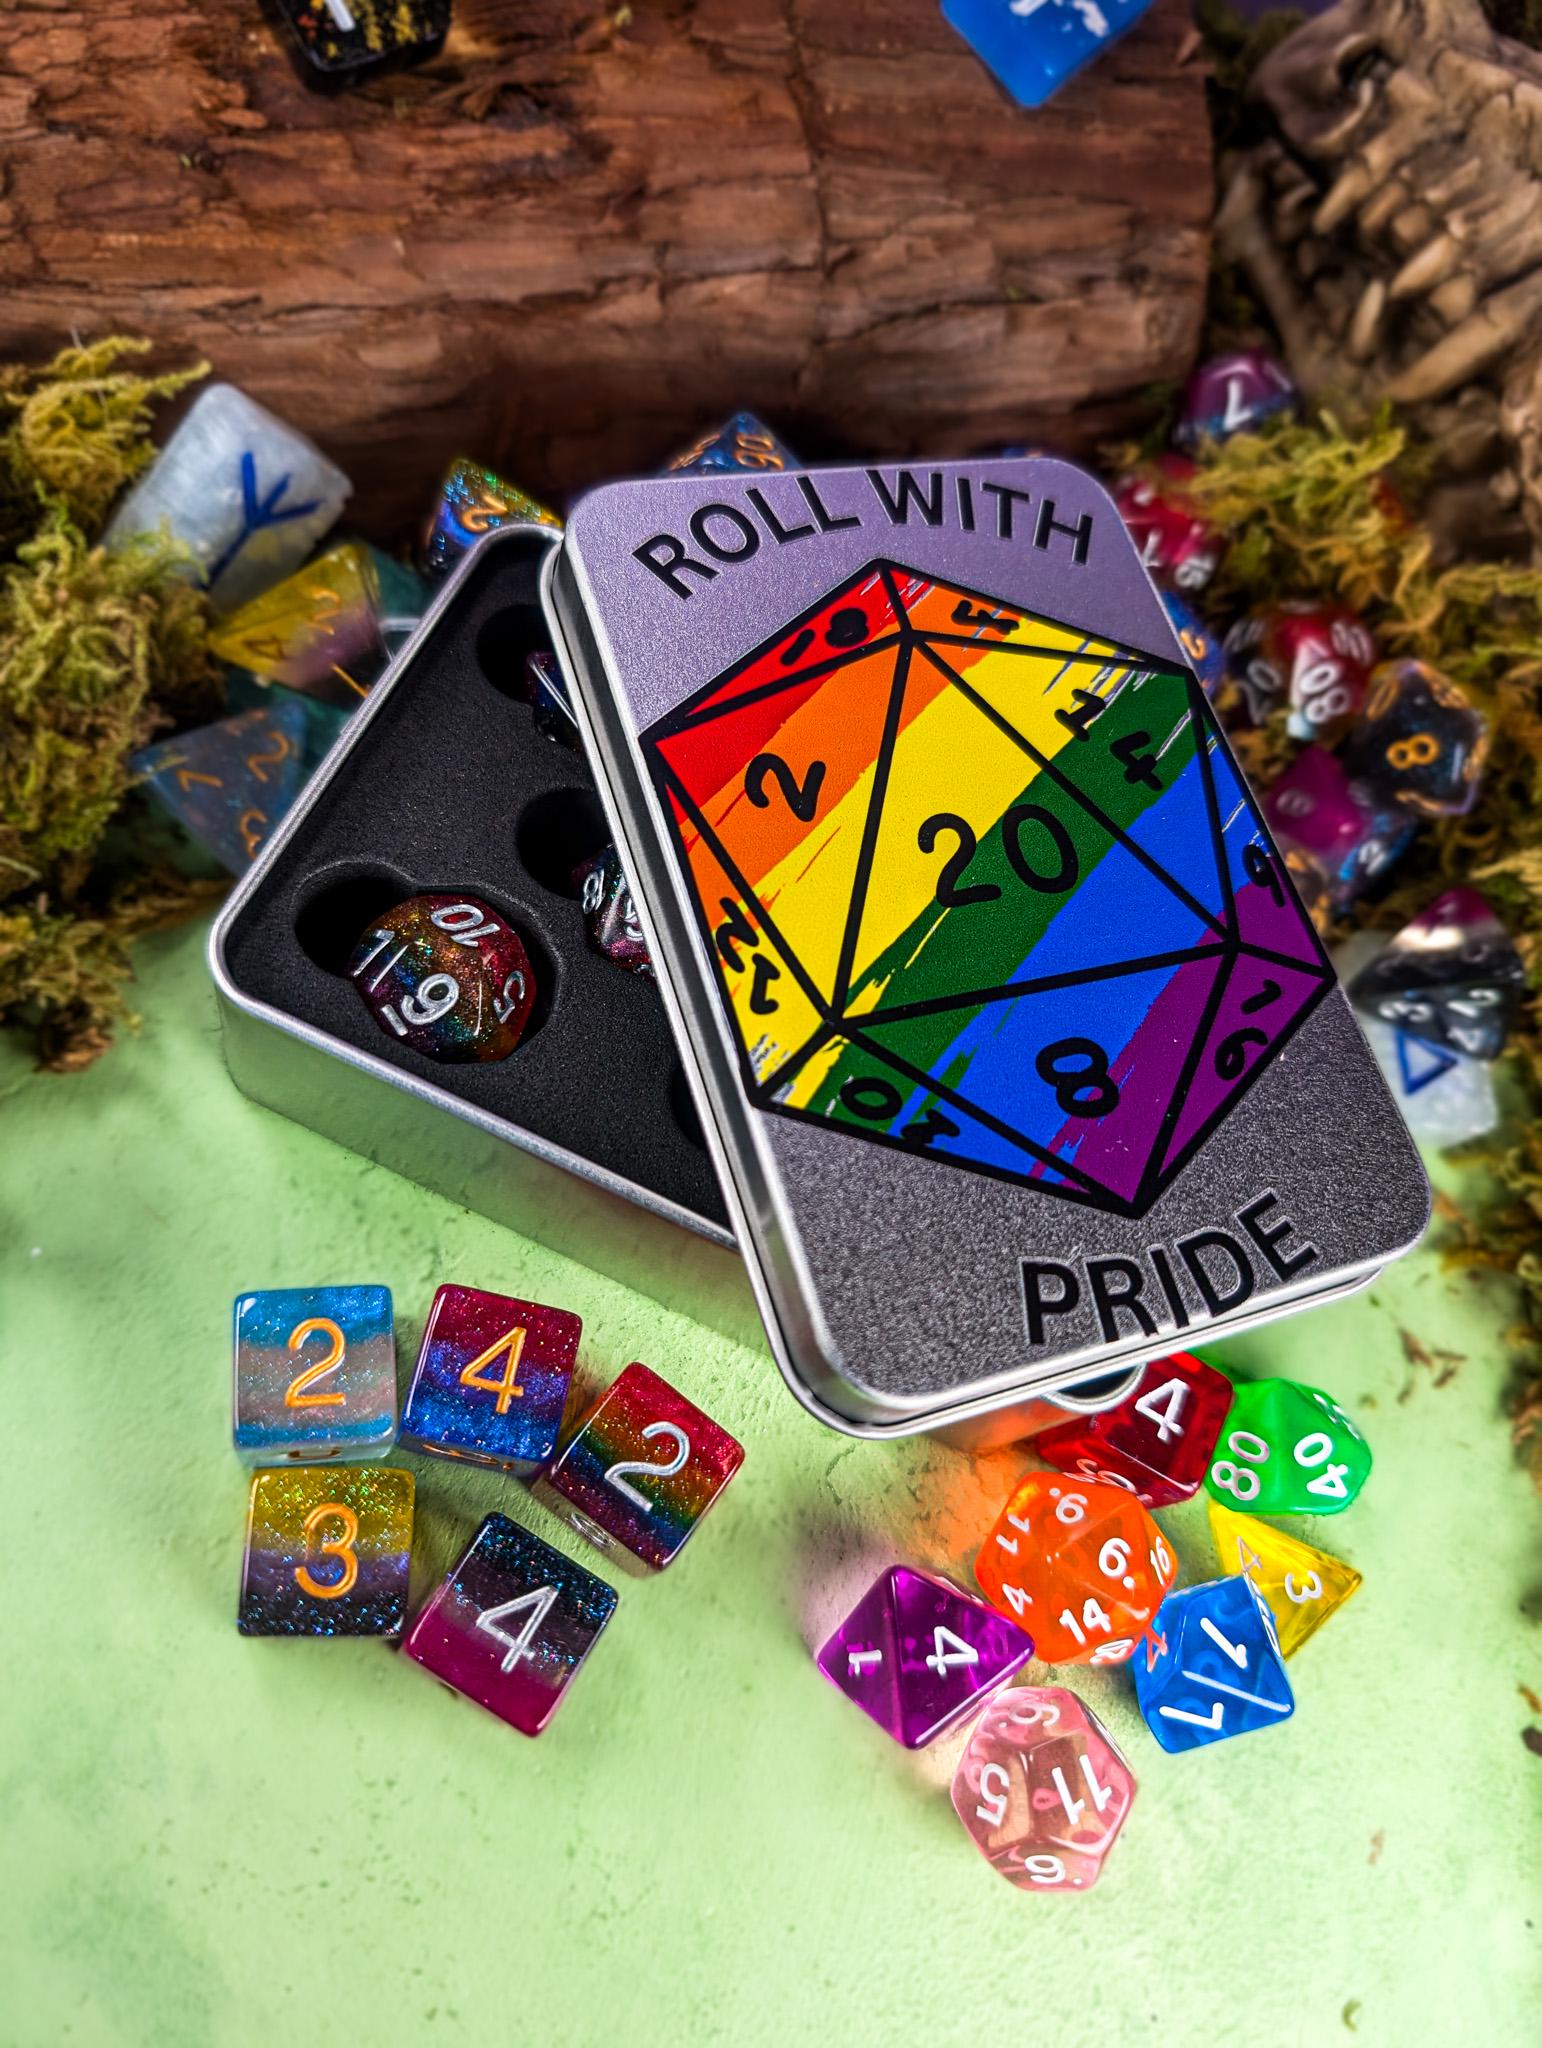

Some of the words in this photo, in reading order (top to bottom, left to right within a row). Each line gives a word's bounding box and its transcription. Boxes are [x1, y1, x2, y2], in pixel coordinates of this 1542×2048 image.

[631, 475, 863, 600] ROLL
[864, 469, 1094, 567] WITH
[744, 752, 827, 822] 2
[917, 803, 1080, 909] 20
[1035, 1036, 1120, 1118] 8
[1021, 1191, 1319, 1345] PRIDE
[285, 1316, 347, 1409] 2
[460, 1326, 526, 1415] 4
[1134, 1377, 1191, 1445] 4
[604, 1421, 691, 1513] 2
[1211, 1430, 1271, 1501] 80
[1293, 1431, 1349, 1498] 40
[295, 1502, 359, 1600] 3
[476, 1584, 563, 1674] 4
[925, 1625, 980, 1677] 4
[1058, 1597, 1112, 1646] 14
[976, 1762, 1011, 1827] 5
[1051, 1754, 1113, 1825] 11
